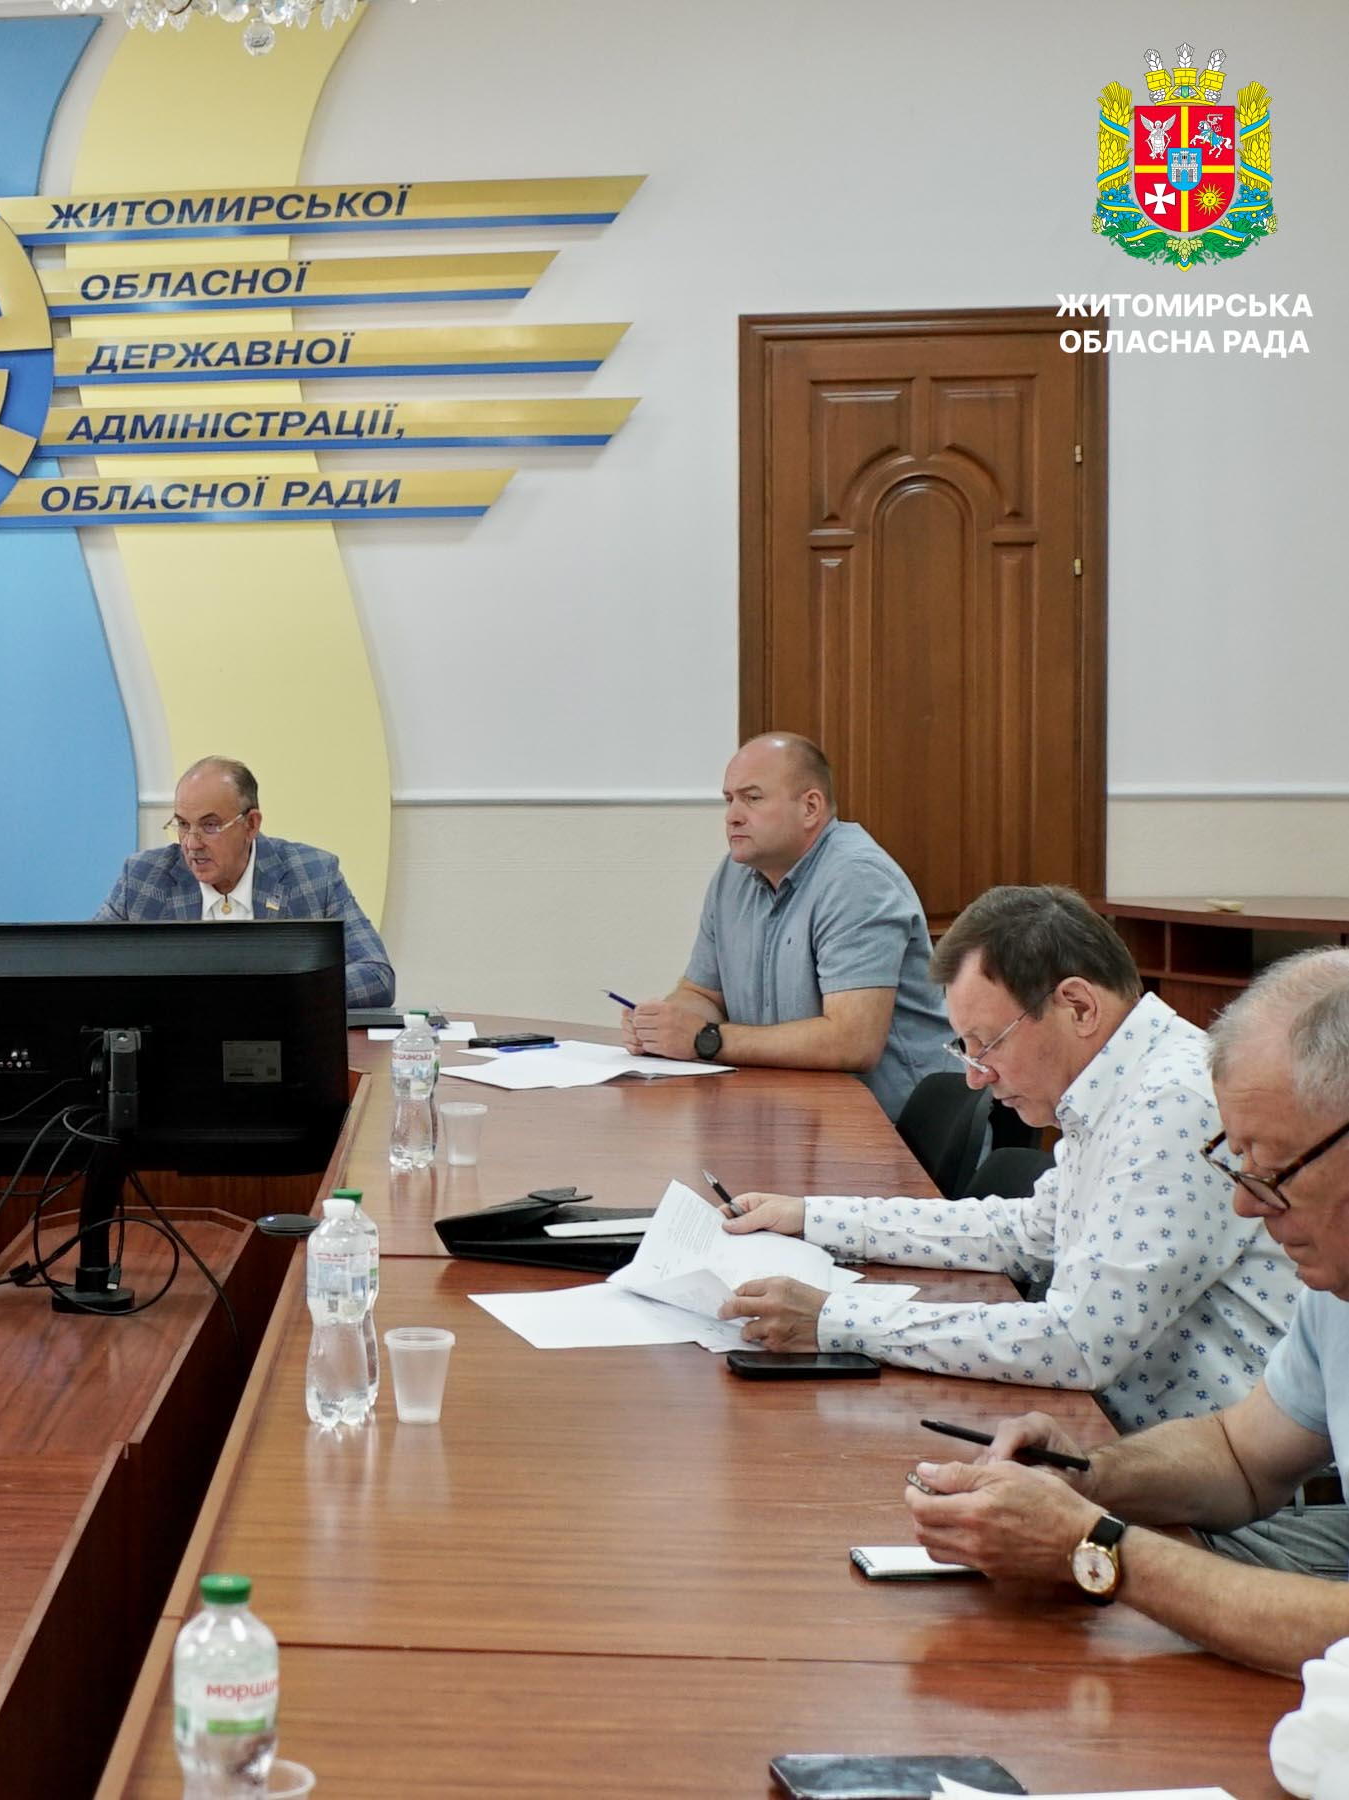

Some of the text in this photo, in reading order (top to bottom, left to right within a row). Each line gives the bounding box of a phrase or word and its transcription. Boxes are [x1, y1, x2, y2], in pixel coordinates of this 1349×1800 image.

[46, 184, 413, 229] ЖИТОМИРСЬКОЇ
[80, 261, 312, 301] ОБЛАСНОЇ
[85, 332, 356, 375] ДЕРЖАВНОЇ
[66, 403, 406, 444] АДМІНІСТРАЦІЇ,
[40, 475, 402, 513] ОБЛАСНОЇ РАДИ
